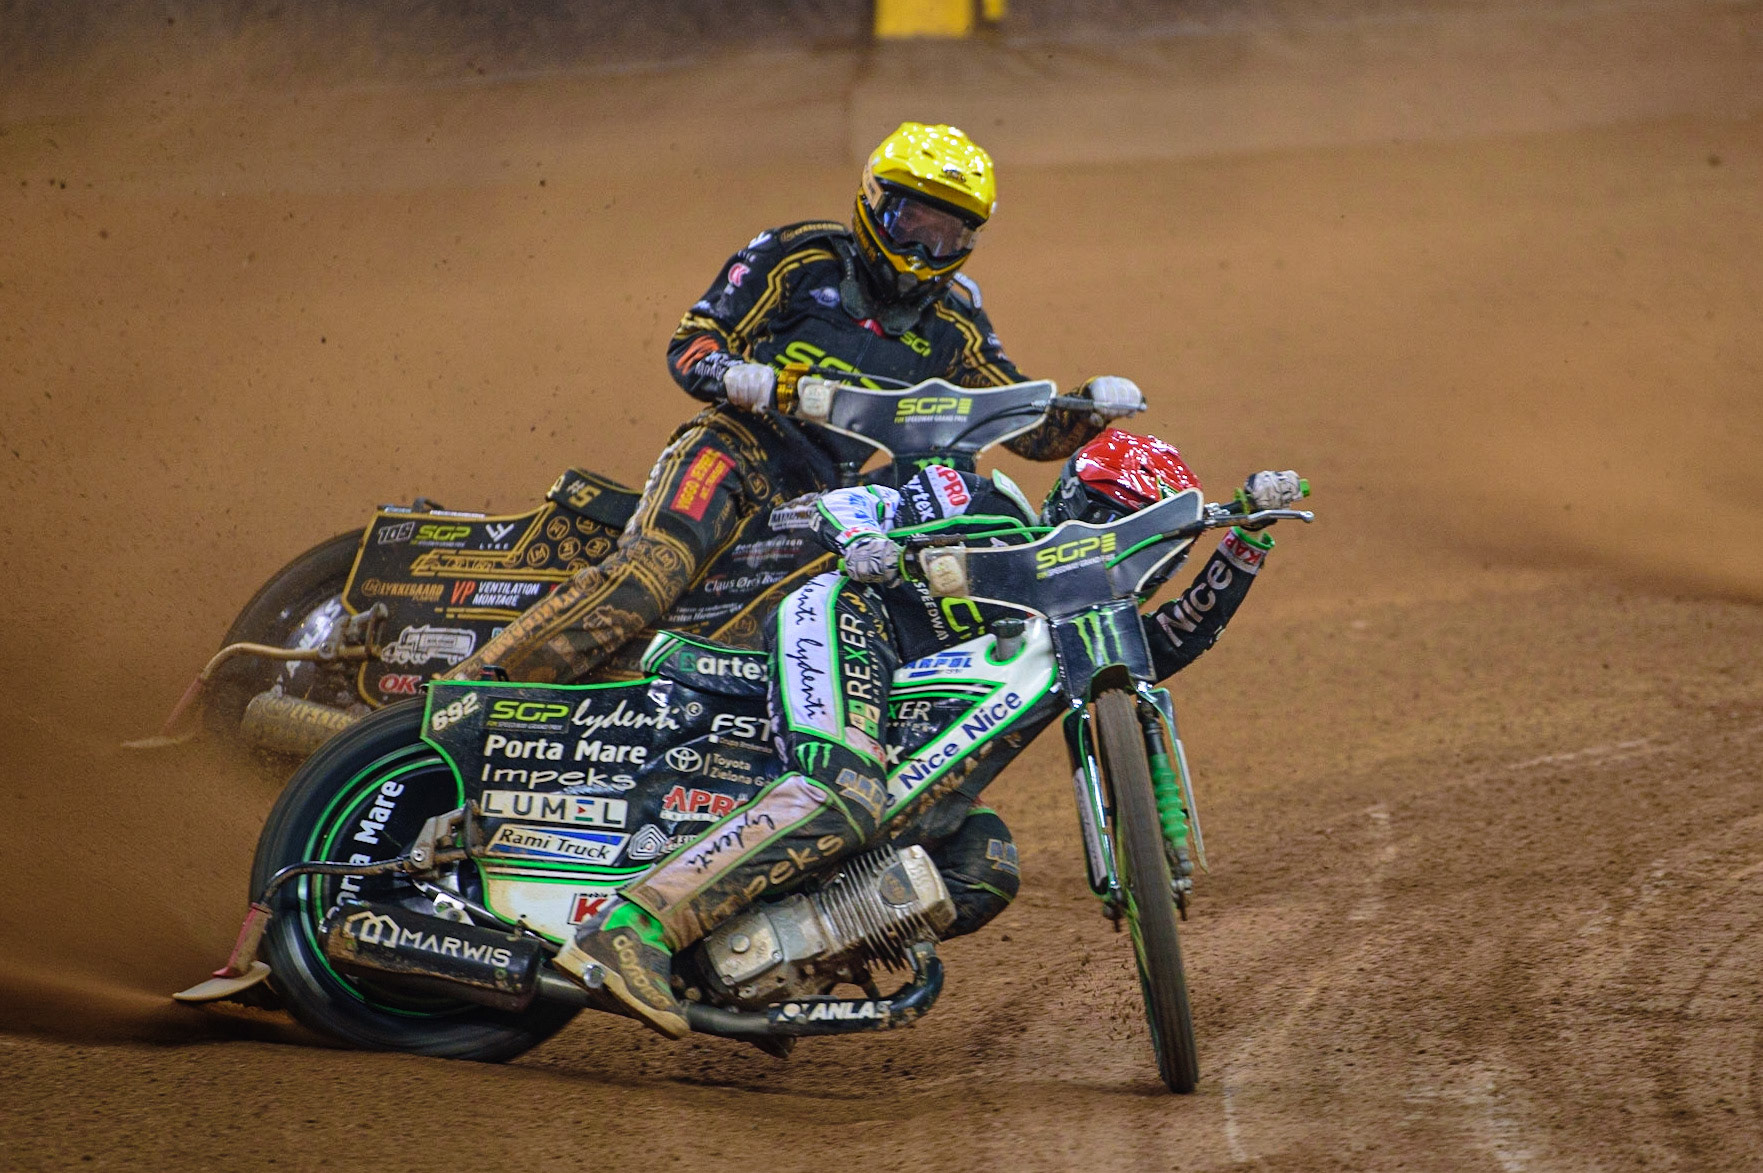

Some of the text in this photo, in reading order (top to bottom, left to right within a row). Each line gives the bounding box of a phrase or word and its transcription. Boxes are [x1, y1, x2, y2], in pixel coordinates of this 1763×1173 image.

[415, 525, 471, 541] SGP
[450, 581, 477, 605] VP
[472, 594, 519, 607] MONTAGE
[478, 582, 540, 596] VENTILATION
[1156, 560, 1233, 648] Nice
[840, 613, 873, 699] REXER
[379, 674, 422, 695] OK
[431, 692, 480, 731] 692
[489, 700, 569, 723] SGP
[887, 701, 931, 721] XER
[484, 734, 647, 764] Porta Mare
[898, 743, 961, 790] Nice
[961, 692, 1023, 741] Nice
[713, 753, 751, 771] Toyota
[481, 763, 636, 791] Impeks
[353, 780, 405, 845] Mare
[663, 785, 746, 816] APR
[500, 829, 611, 860] Rami Truck
[400, 930, 513, 967] MARWIS
